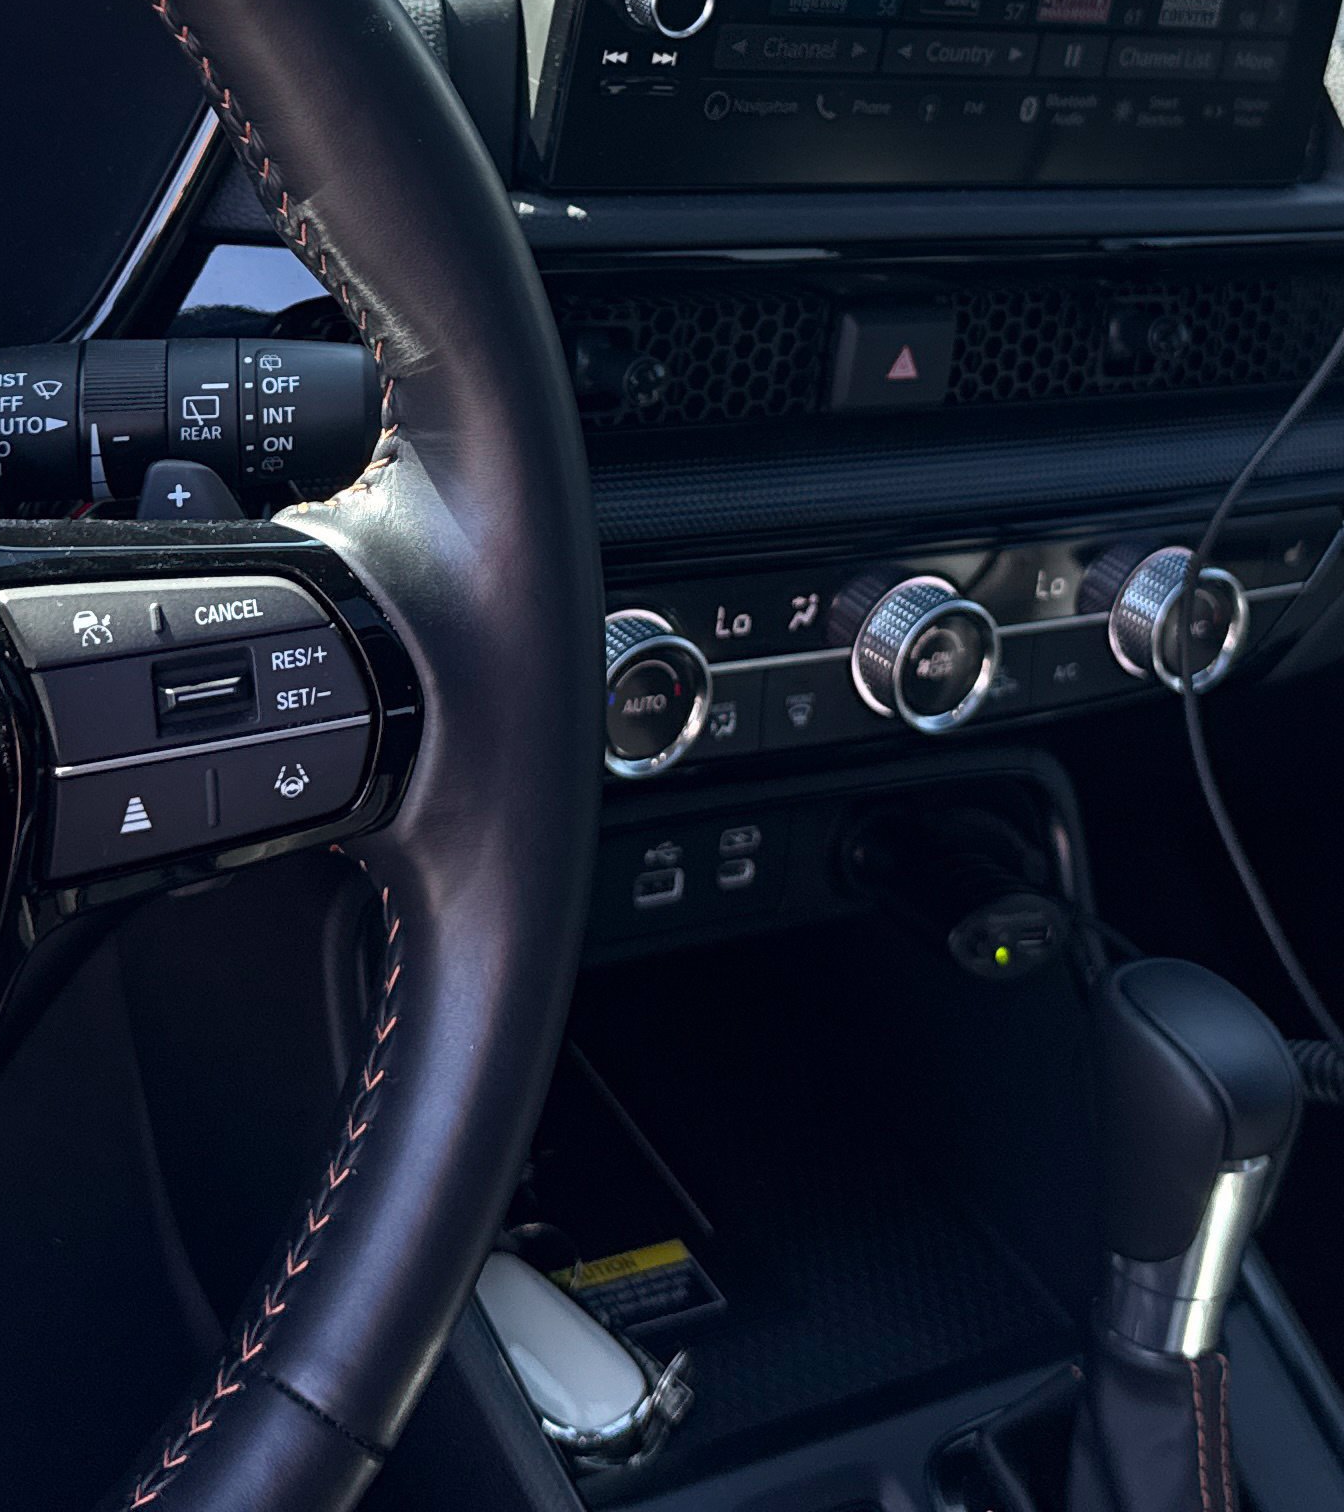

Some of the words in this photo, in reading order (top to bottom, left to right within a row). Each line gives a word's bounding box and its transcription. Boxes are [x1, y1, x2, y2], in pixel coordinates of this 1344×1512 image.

[1003, 2, 1026, 21] 57
[763, 37, 839, 59] Channel
[925, 42, 998, 67] Country
[1118, 46, 1181, 68] Channel
[1184, 49, 1211, 69] List
[261, 374, 301, 394] OFF
[262, 406, 296, 425] INT
[180, 425, 222, 442] REAR
[262, 435, 294, 453] ON
[194, 598, 264, 626] CANCEL
[271, 646, 328, 671] RES/+
[621, 693, 668, 715] AUTO
